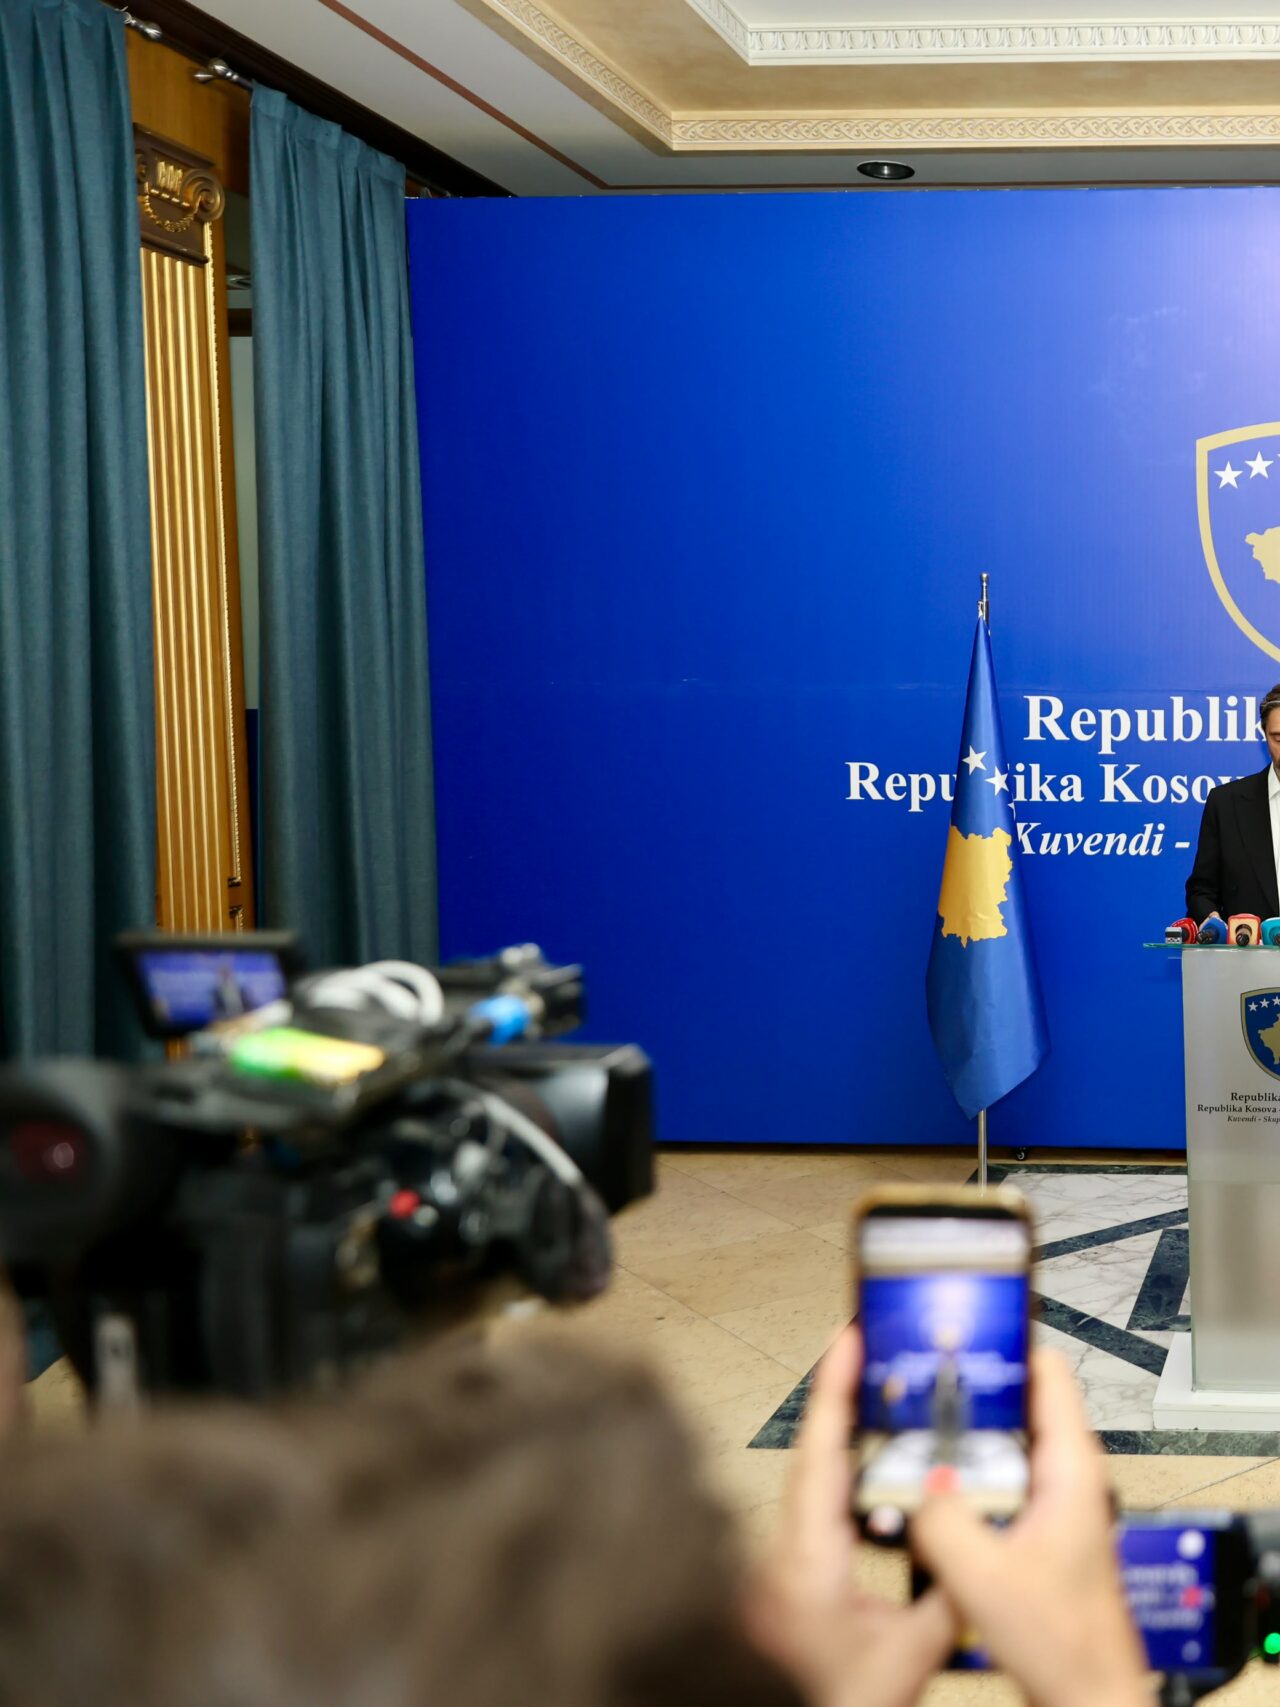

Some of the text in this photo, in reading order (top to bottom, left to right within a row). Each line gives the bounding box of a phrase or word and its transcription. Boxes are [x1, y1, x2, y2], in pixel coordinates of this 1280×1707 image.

[1023, 695, 1266, 755] Republik
[845, 762, 1085, 812] Repuika
[1100, 763, 1246, 804] Koso
[1016, 822, 1165, 856] Kuvendi
[1197, 1104, 1243, 1115] Republika
[1245, 1105, 1277, 1114] Kosova
[1226, 1114, 1257, 1123] Kuvendi
